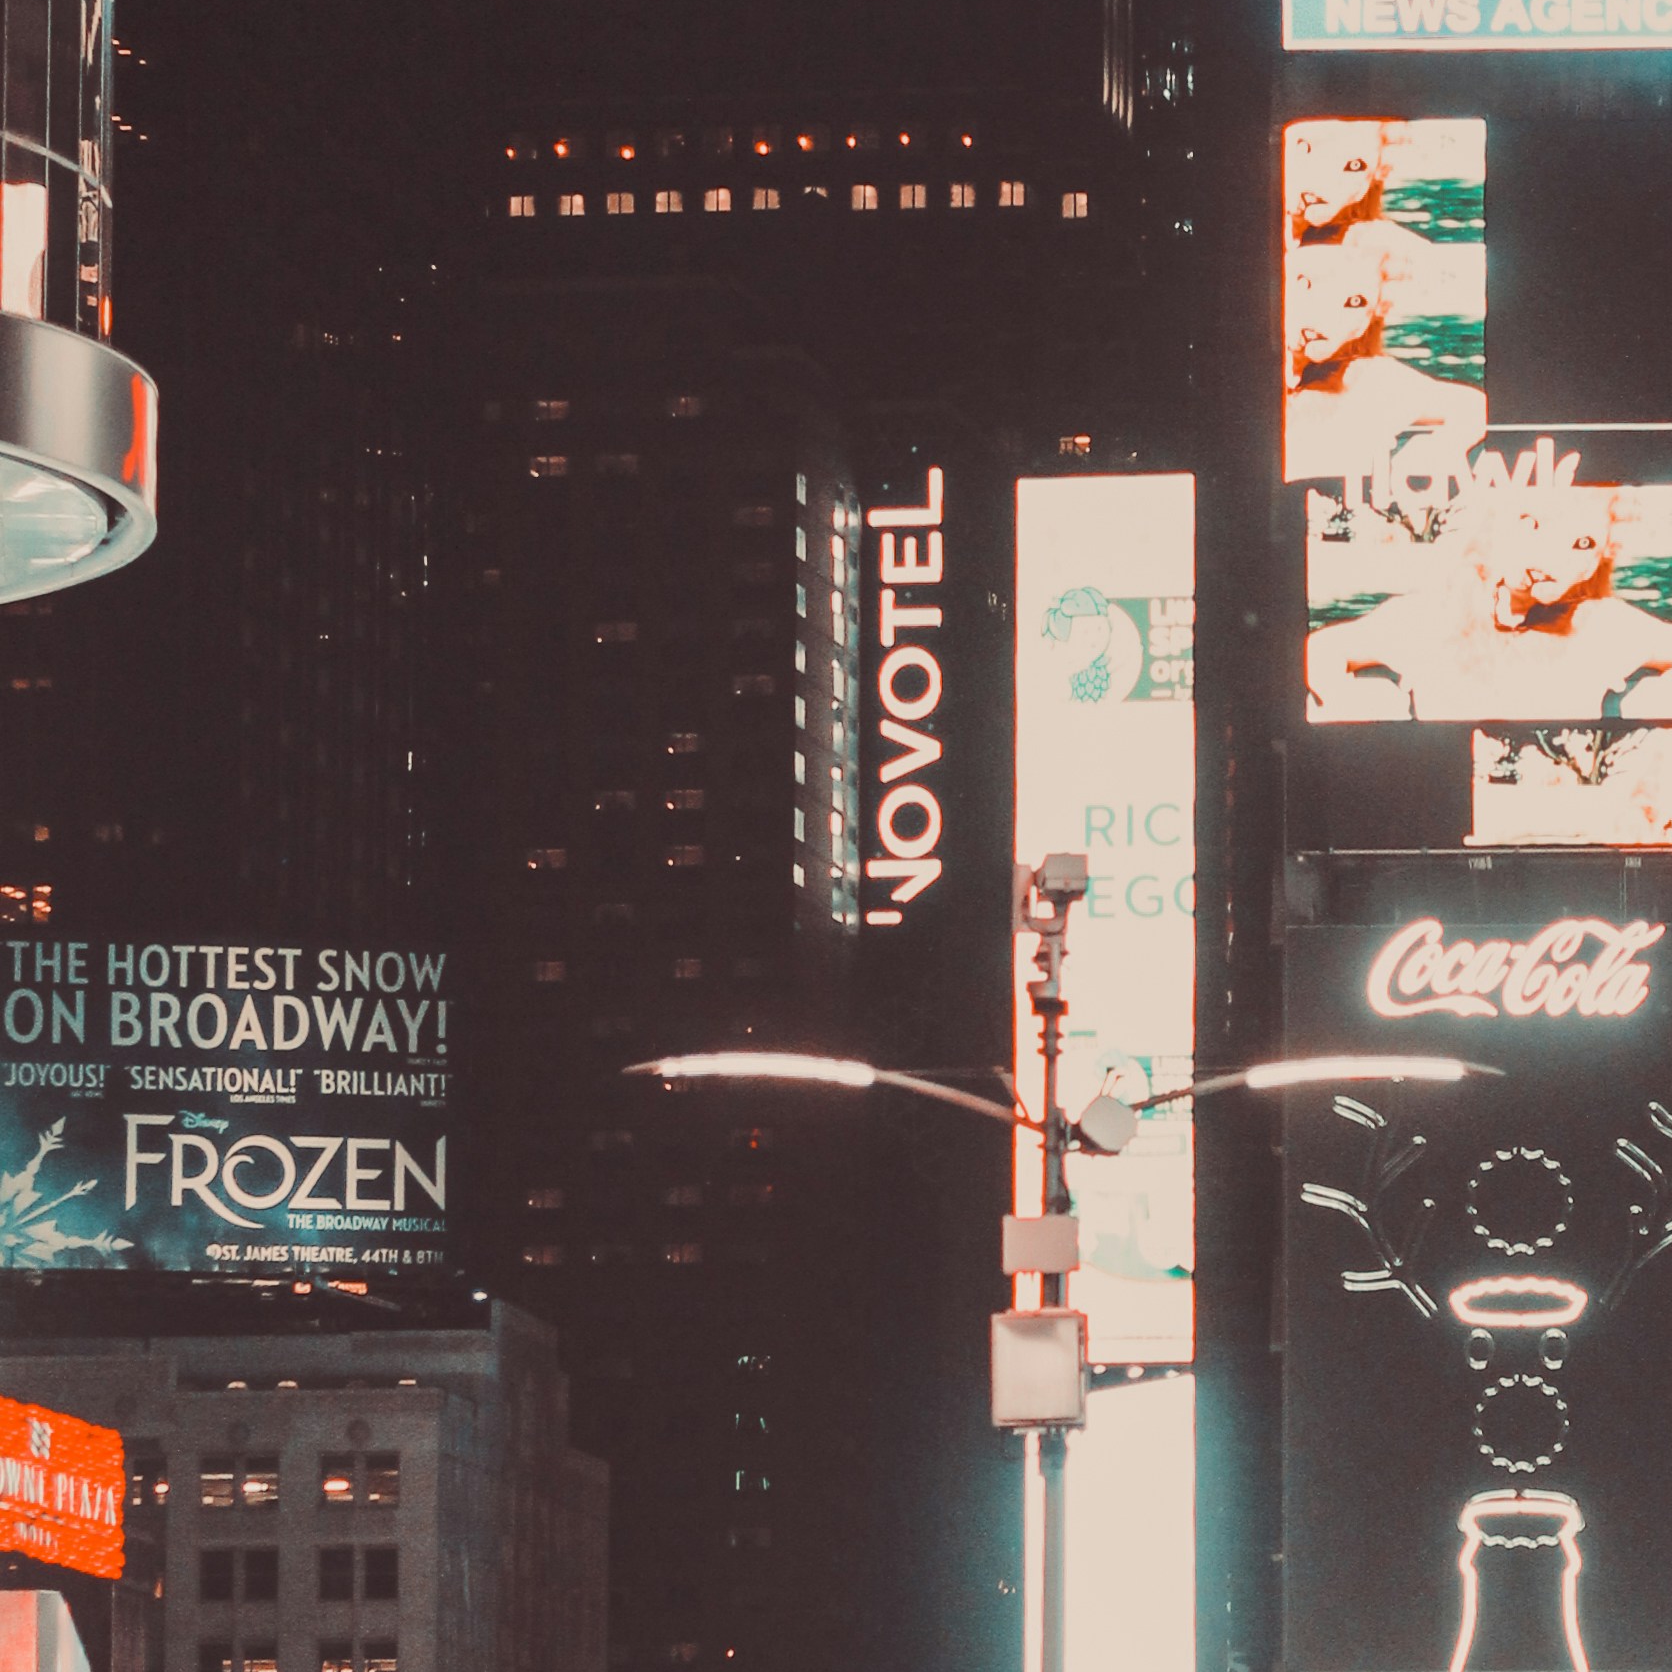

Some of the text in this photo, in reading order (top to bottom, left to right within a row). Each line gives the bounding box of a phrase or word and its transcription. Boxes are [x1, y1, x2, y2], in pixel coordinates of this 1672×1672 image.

[866, 465, 944, 926] NOVOTEL
[107, 943, 302, 991] HOTTEST
[316, 948, 447, 993] SNOW
[1366, 916, 1666, 1018] Coca-Cola
[4, 987, 85, 1044] ON
[177, 1110, 230, 1135] Disney
[122, 1113, 447, 1230] FROZEN
[287, 1213, 314, 1230] THE
[315, 1213, 389, 1232] BROADWAY
[243, 1243, 289, 1262] JAMES
[291, 1245, 359, 1265] THEATRE,
[360, 1247, 399, 1264] 44TH
[401, 1249, 413, 1265] &
